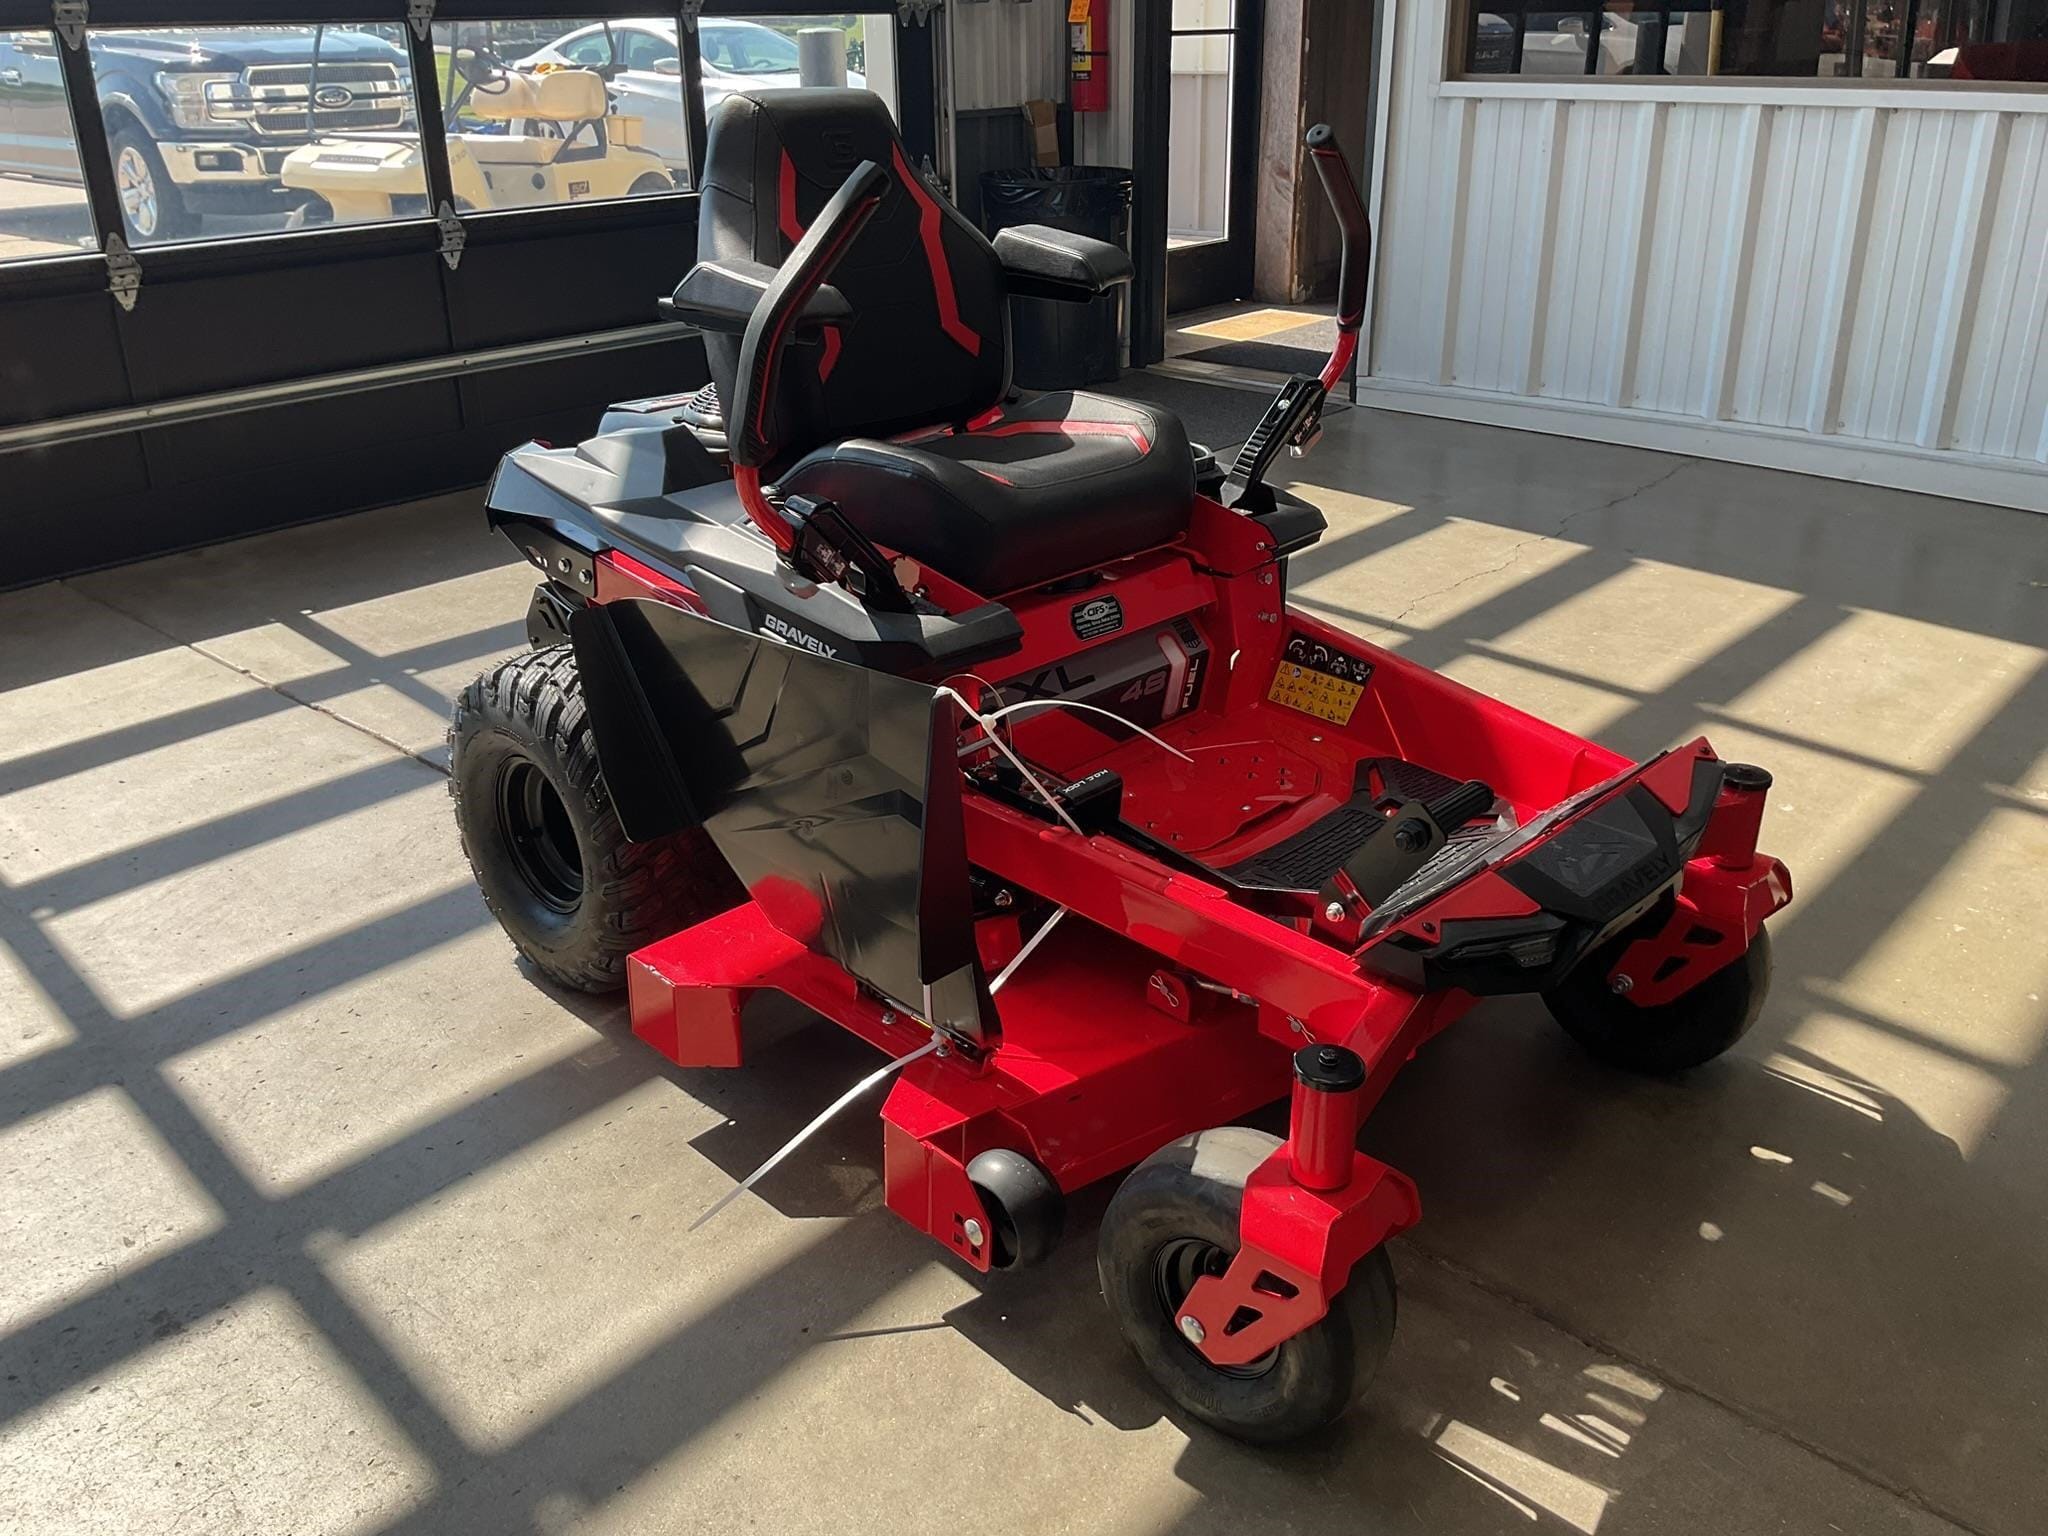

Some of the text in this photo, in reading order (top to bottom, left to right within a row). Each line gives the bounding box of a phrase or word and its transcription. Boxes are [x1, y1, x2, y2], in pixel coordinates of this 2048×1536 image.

[1087, 604, 1105, 617] CIFS
[764, 613, 837, 659] GRAVELY
[1007, 666, 1096, 700] XL
[1120, 671, 1167, 703] 48
[1182, 658, 1200, 709] FUEL
[1062, 779, 1087, 794] LOCK
